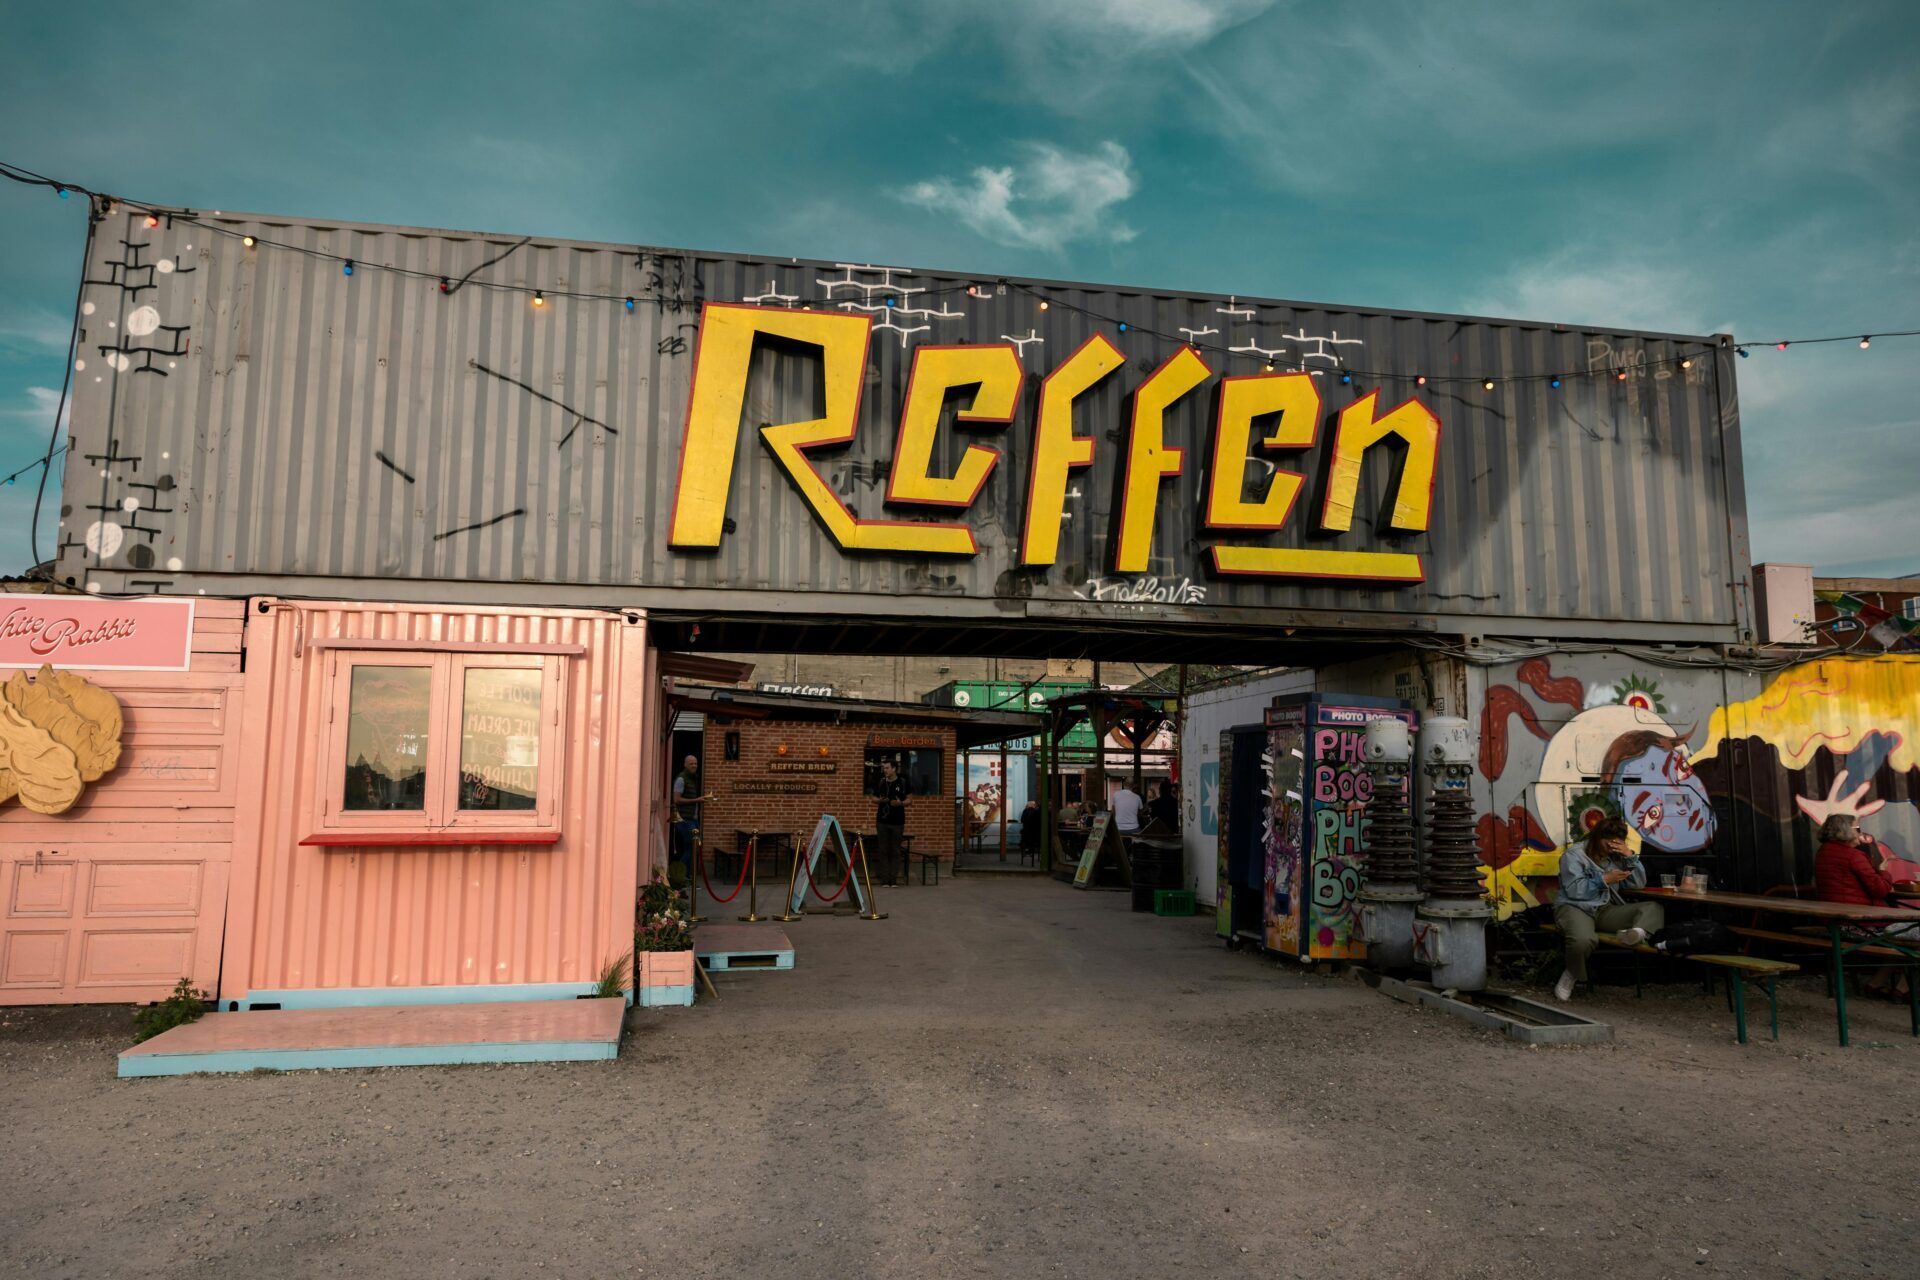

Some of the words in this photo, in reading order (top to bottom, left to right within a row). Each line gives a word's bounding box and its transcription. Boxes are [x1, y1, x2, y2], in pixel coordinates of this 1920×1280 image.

[667, 302, 1442, 578] Reffen
[30, 617, 137, 656] Rabbit
[1331, 711, 1363, 722] PHOTO
[1366, 713, 1397, 722] BOO
[873, 735, 897, 745] Beer
[900, 736, 936, 746] Garden
[770, 762, 805, 771] REFFEN
[808, 763, 835, 771] BREW
[733, 783, 772, 791] LOCALLY
[774, 783, 817, 792] PRODUCED
